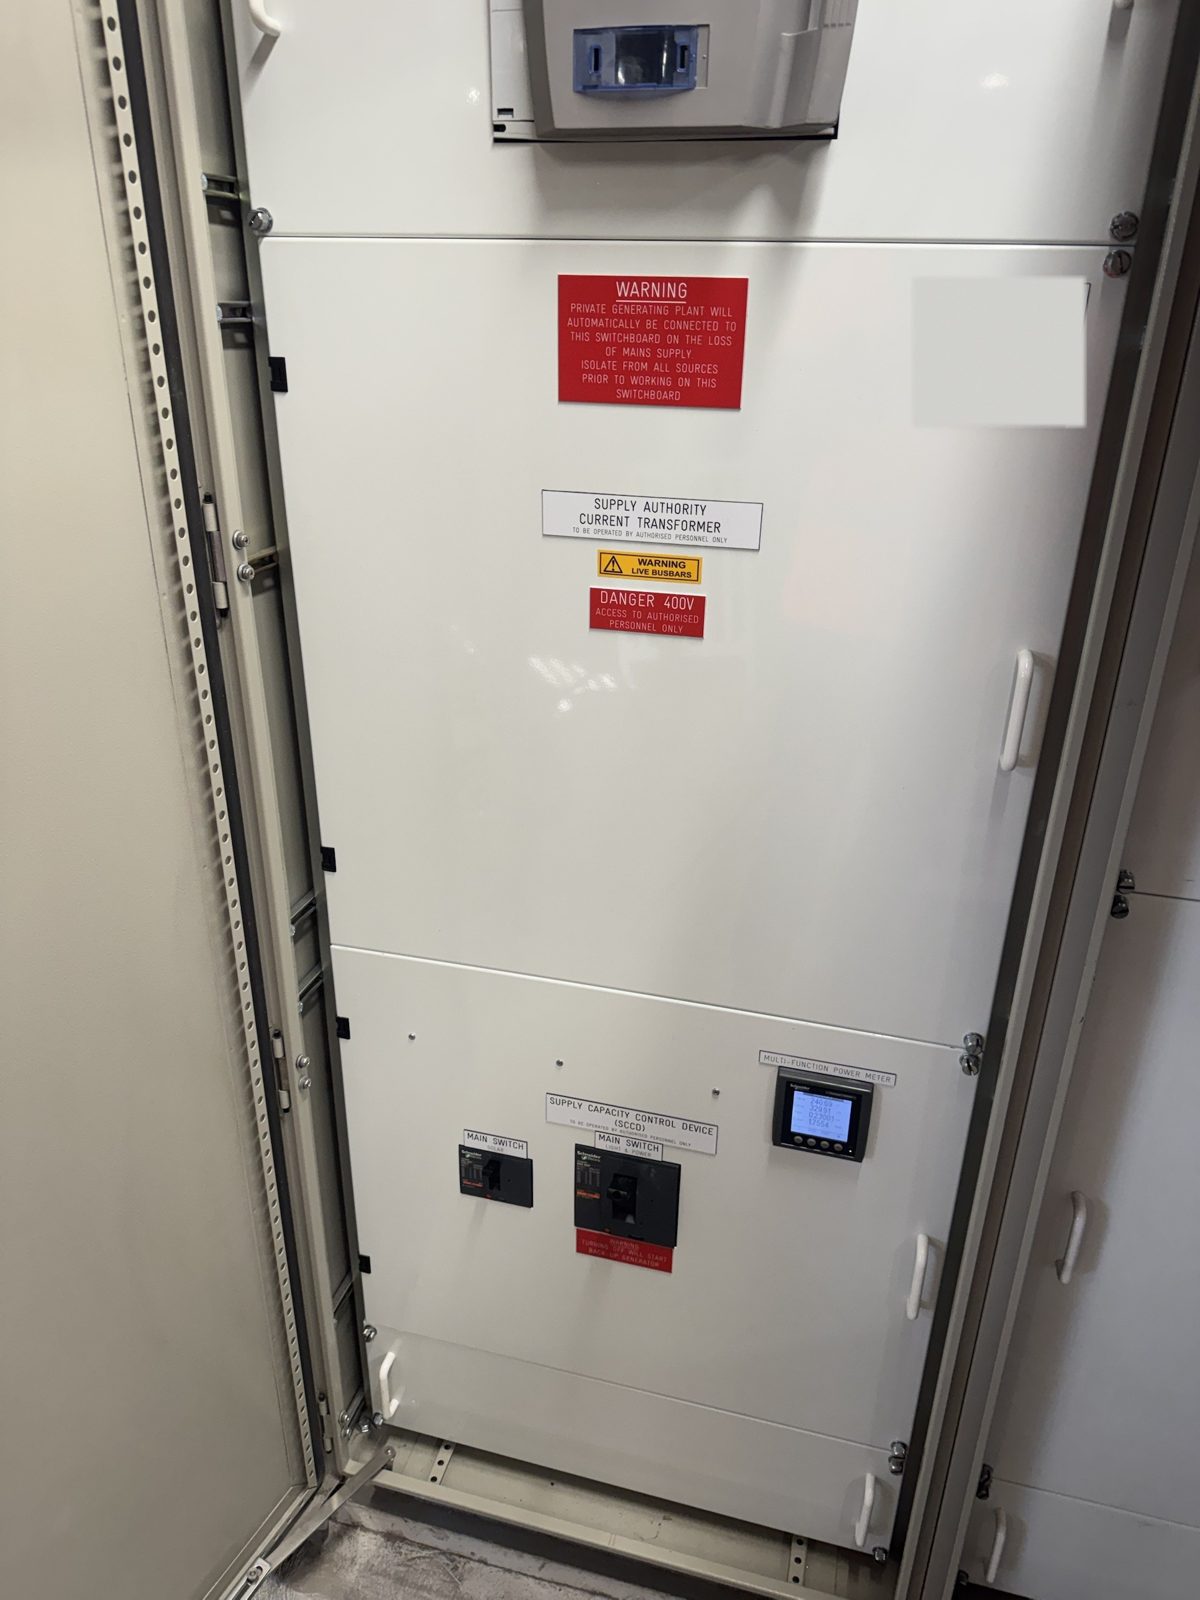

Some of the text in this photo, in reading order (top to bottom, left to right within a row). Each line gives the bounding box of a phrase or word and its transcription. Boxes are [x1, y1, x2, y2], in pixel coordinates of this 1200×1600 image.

[616, 281, 688, 299] WARNING
[571, 303, 732, 318] PRIVATE GENERATING PLANT WILL
[567, 317, 737, 332] AUTOMATICALLY BE CONNECTED TO
[570, 331, 732, 346] THIS SWITCHBOARD ON THE LOSS
[605, 346, 617, 357] OF
[623, 347, 651, 358] MAINS
[581, 360, 719, 375] ISOLATE FROM ALL SOURCES
[582, 373, 717, 388] PRIOR TO WORKING ON THIS
[616, 388, 681, 401] SWITCHBOARD
[594, 497, 707, 516] SUPPLY AUTHORITY
[579, 513, 721, 534] CURRENT TRANSFORMER
[572, 526, 580, 534] TO
[593, 528, 623, 537] OPERATED
[636, 531, 672, 540] AUTHORISED
[675, 533, 709, 543] PERSONNEL
[712, 536, 728, 544] ONLY
[638, 558, 686, 569] WARNING
[652, 568, 692, 579] BUSBARS
[600, 590, 695, 610] DANGER 400V
[595, 608, 699, 624] ACCESS TO AUTHORISED
[609, 620, 683, 634] PERSONNEL ONLY
[764, 1054, 891, 1083] MULTI-FUNCTION POWER METER
[550, 1096, 713, 1136] SUPPLY CAPACITY CONTROL DEVICE
[614, 1119, 646, 1132] (SCCD)
[467, 1132, 524, 1150] MAIN SWITCH
[598, 1134, 659, 1152] MAIN SWITCH
